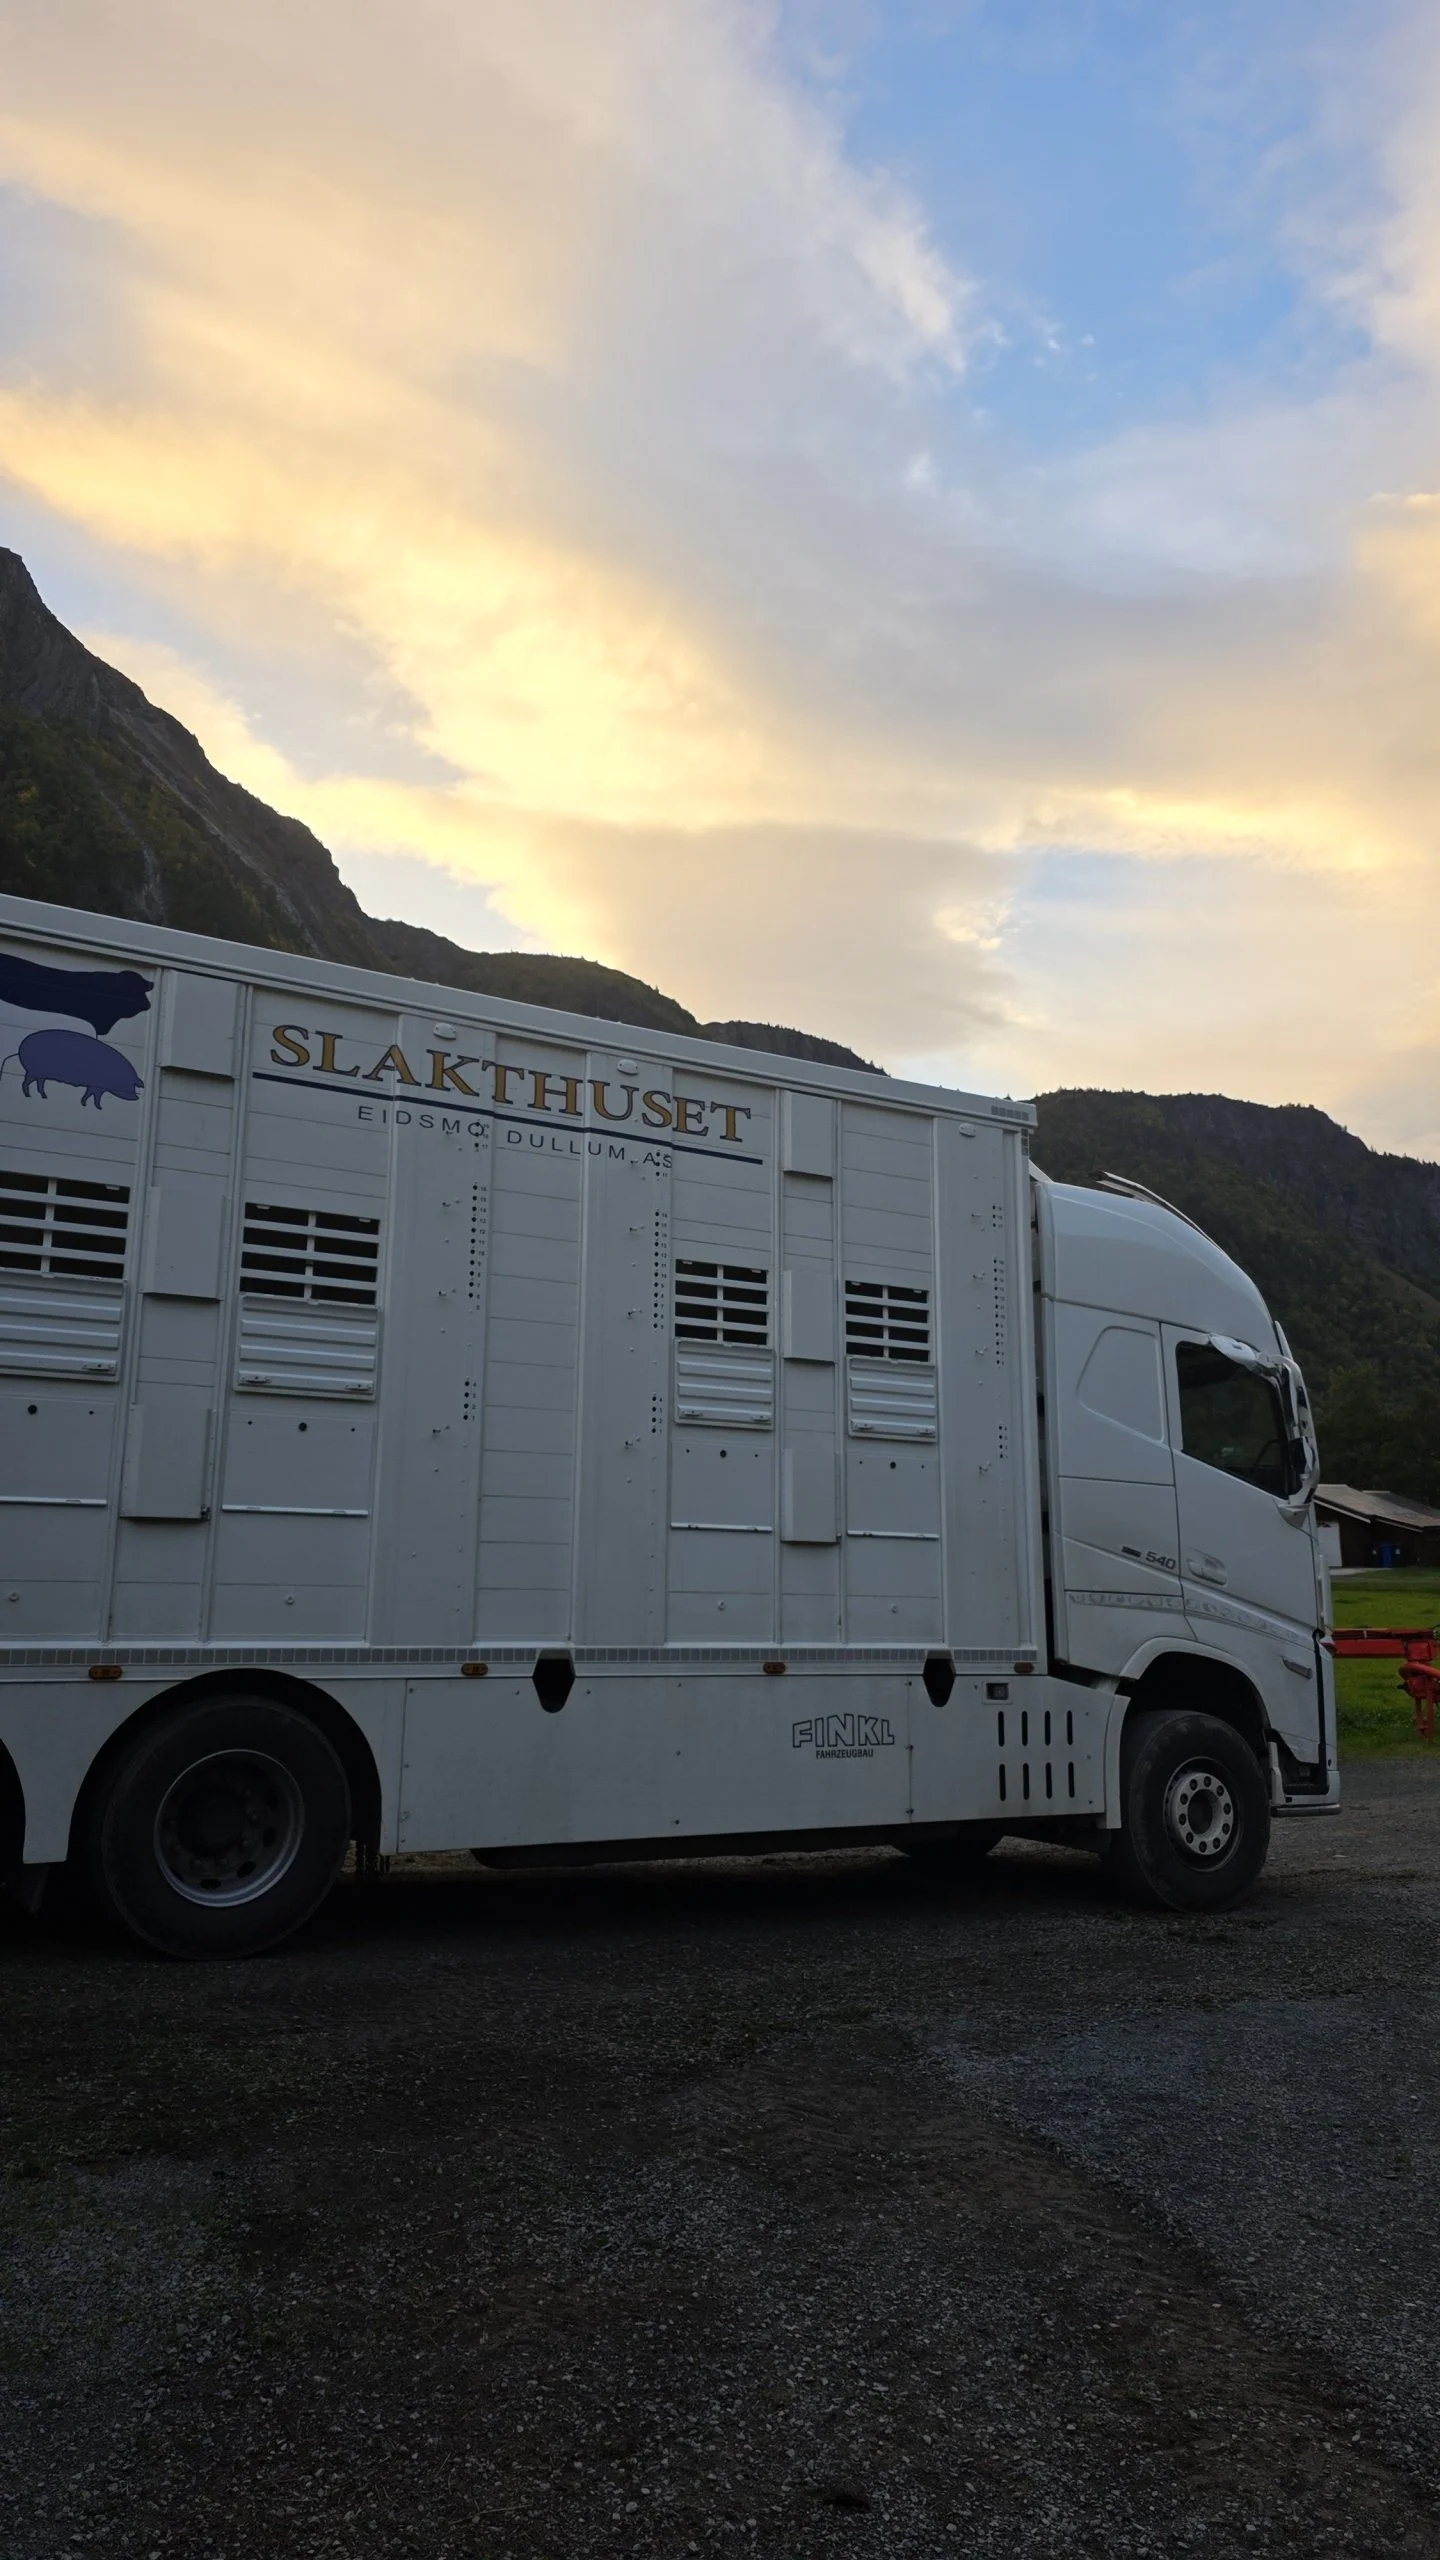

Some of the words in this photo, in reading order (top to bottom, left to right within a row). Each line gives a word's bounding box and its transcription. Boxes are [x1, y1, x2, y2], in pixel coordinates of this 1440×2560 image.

[269, 1024, 751, 1143] SLAKTHUSET
[358, 1105, 485, 1136] EIDSMO
[507, 1131, 625, 1161] DULLUM
[1145, 1550, 1177, 1570] 540
[792, 1713, 895, 1748] FINKL
[816, 1748, 874, 1759] FAHRZEUGBAU
